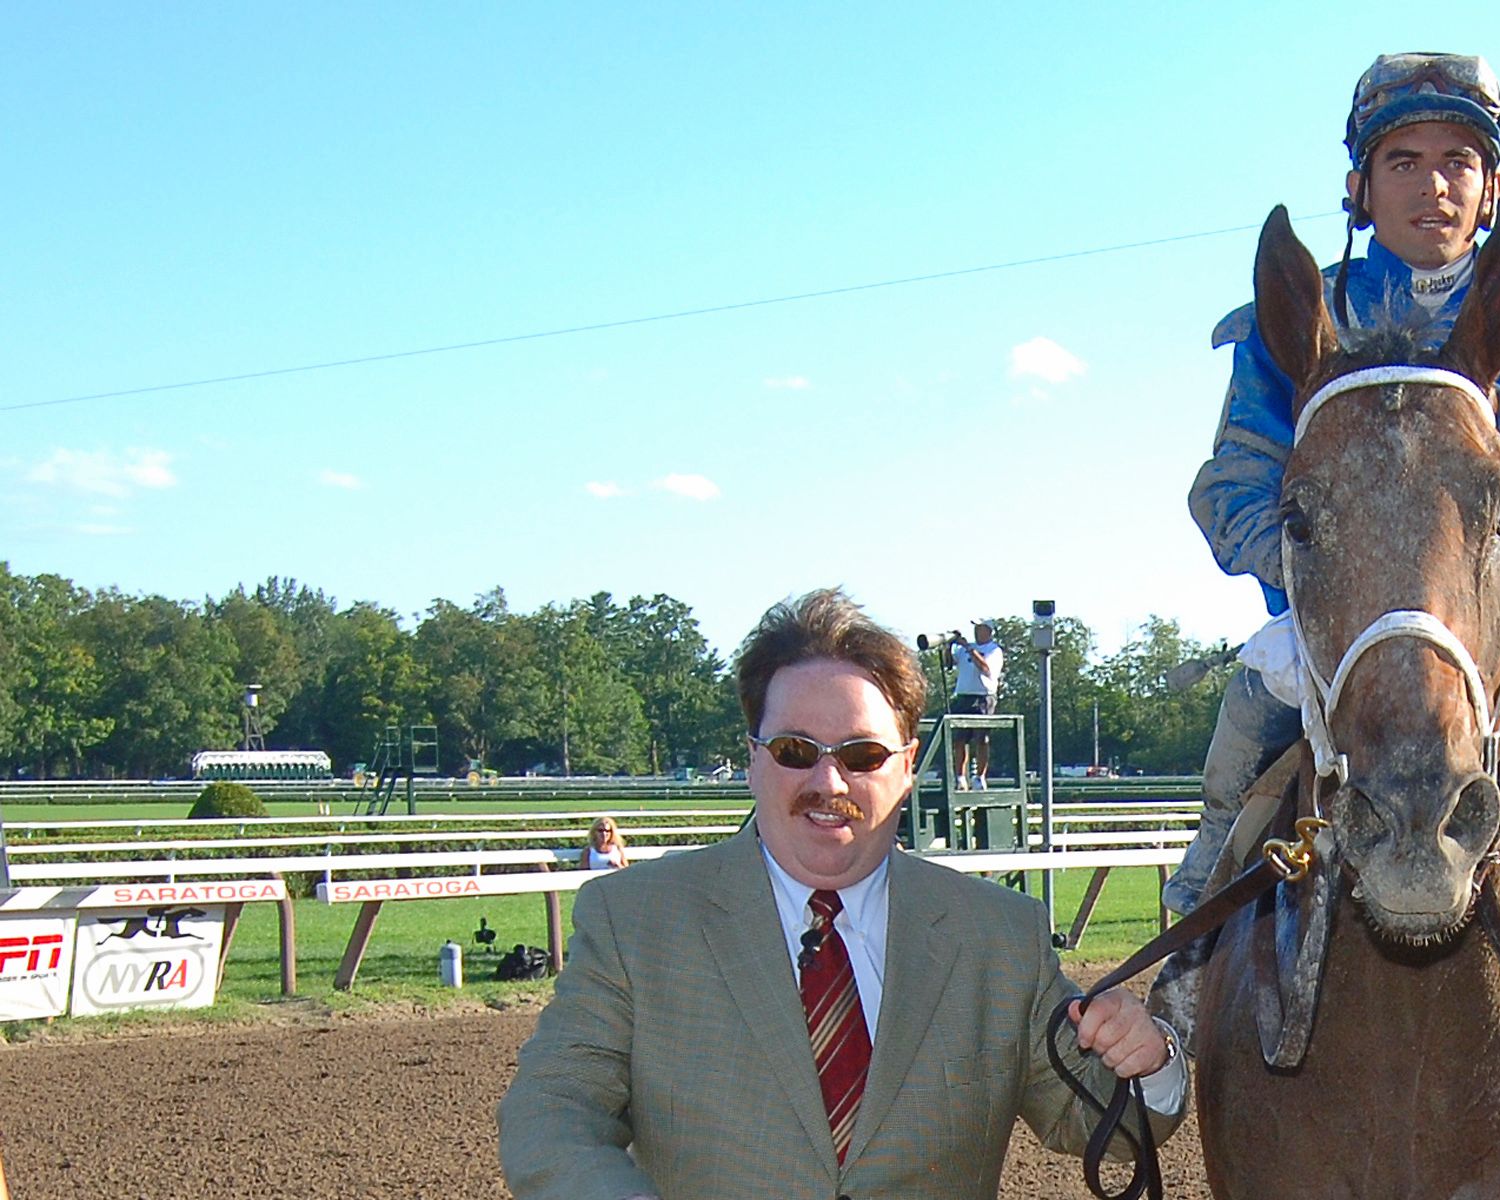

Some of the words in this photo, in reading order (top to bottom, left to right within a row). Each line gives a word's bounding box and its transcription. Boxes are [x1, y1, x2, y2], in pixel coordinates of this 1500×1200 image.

[114, 884, 278, 902] SARATOGA
[334, 880, 480, 899] SARATOGA
[98, 959, 188, 995] NYRA
